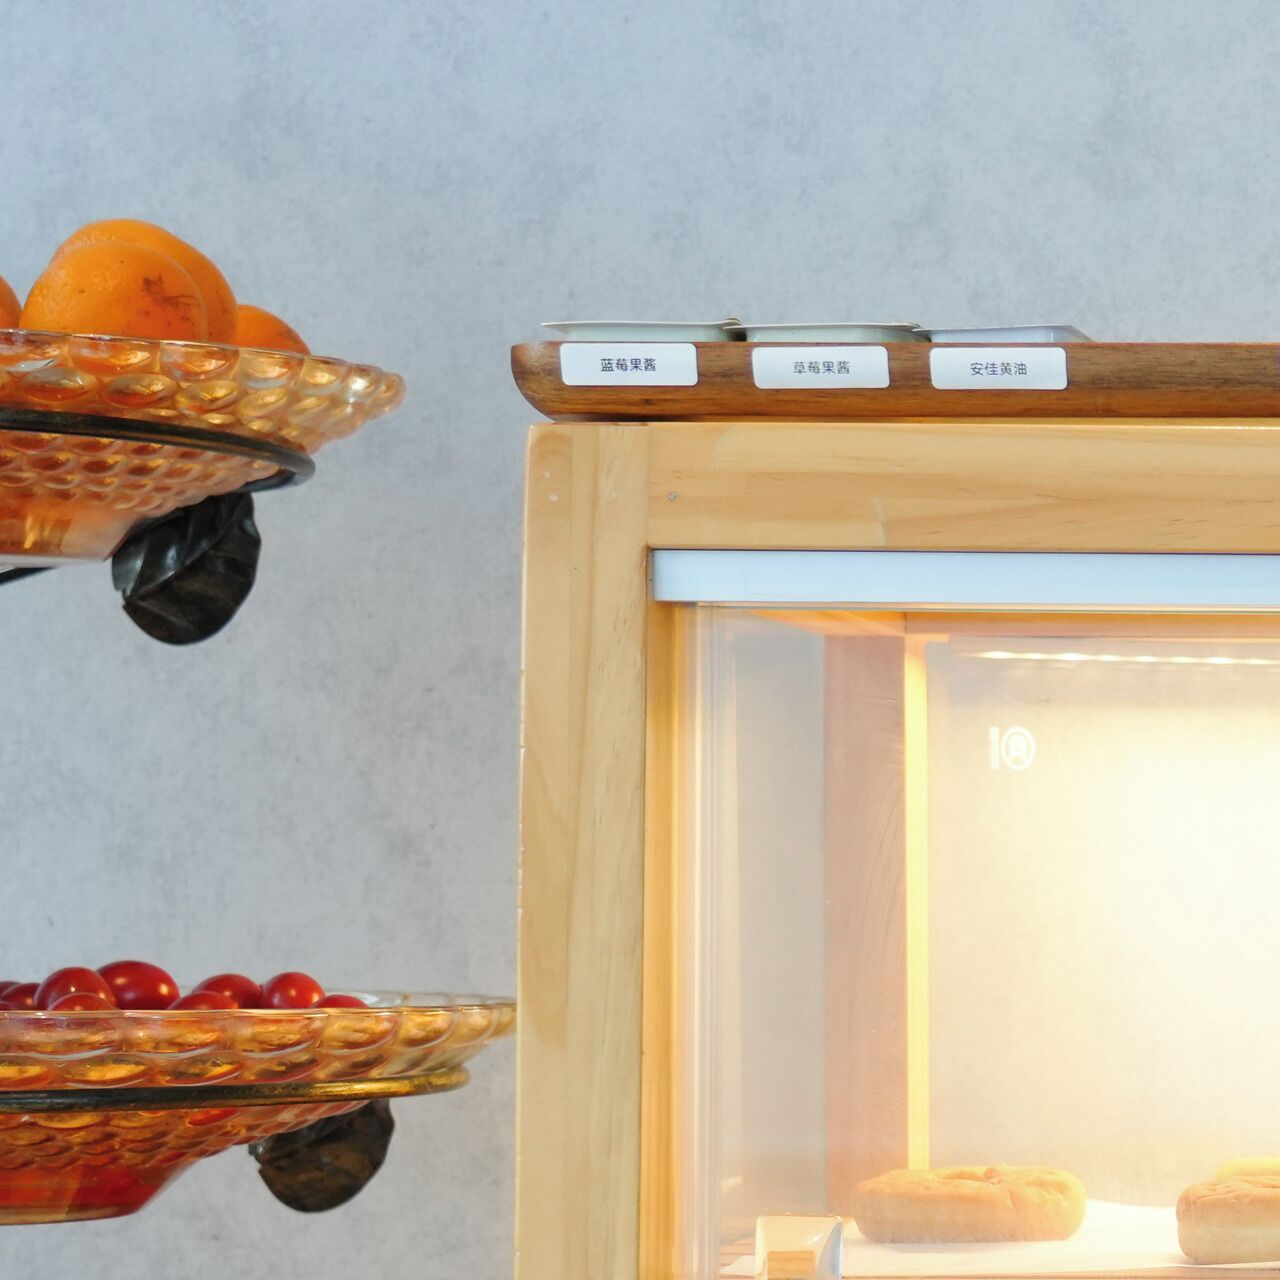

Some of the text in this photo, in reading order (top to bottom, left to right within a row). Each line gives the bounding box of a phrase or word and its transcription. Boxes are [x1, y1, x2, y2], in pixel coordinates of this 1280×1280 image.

[600, 358, 656, 371] 蓝莓果酱
[794, 361, 849, 374] 草莓果酱
[970, 362, 1027, 376] 安佳黄油
